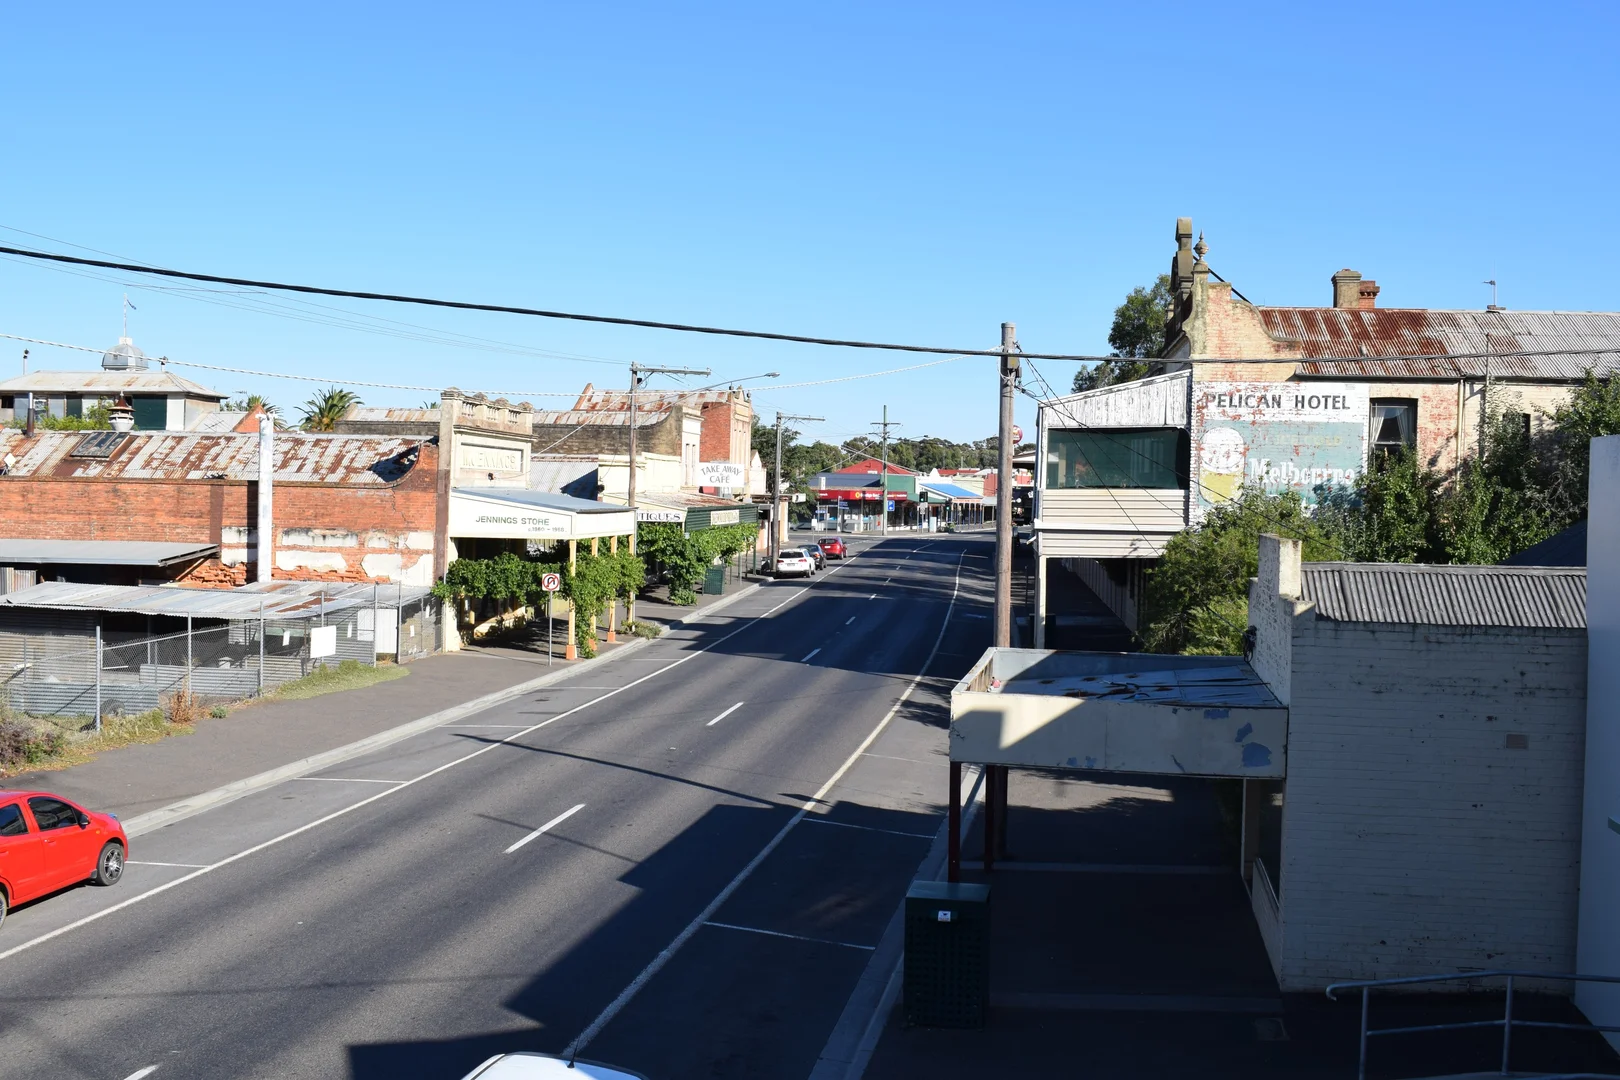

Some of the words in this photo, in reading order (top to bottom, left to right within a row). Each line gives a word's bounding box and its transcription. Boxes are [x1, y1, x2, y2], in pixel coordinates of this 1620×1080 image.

[1205, 393, 1282, 409] PELICAN
[1294, 394, 1351, 410] HOTEL
[700, 465, 721, 476] TAKE
[721, 465, 743, 476] AWAY
[1249, 458, 1356, 485] Melbourne
[709, 475, 730, 484] CAFÉ
[475, 515, 518, 525] JENNINGS
[521, 517, 550, 526] STORE
[637, 512, 682, 521] TIQUES
